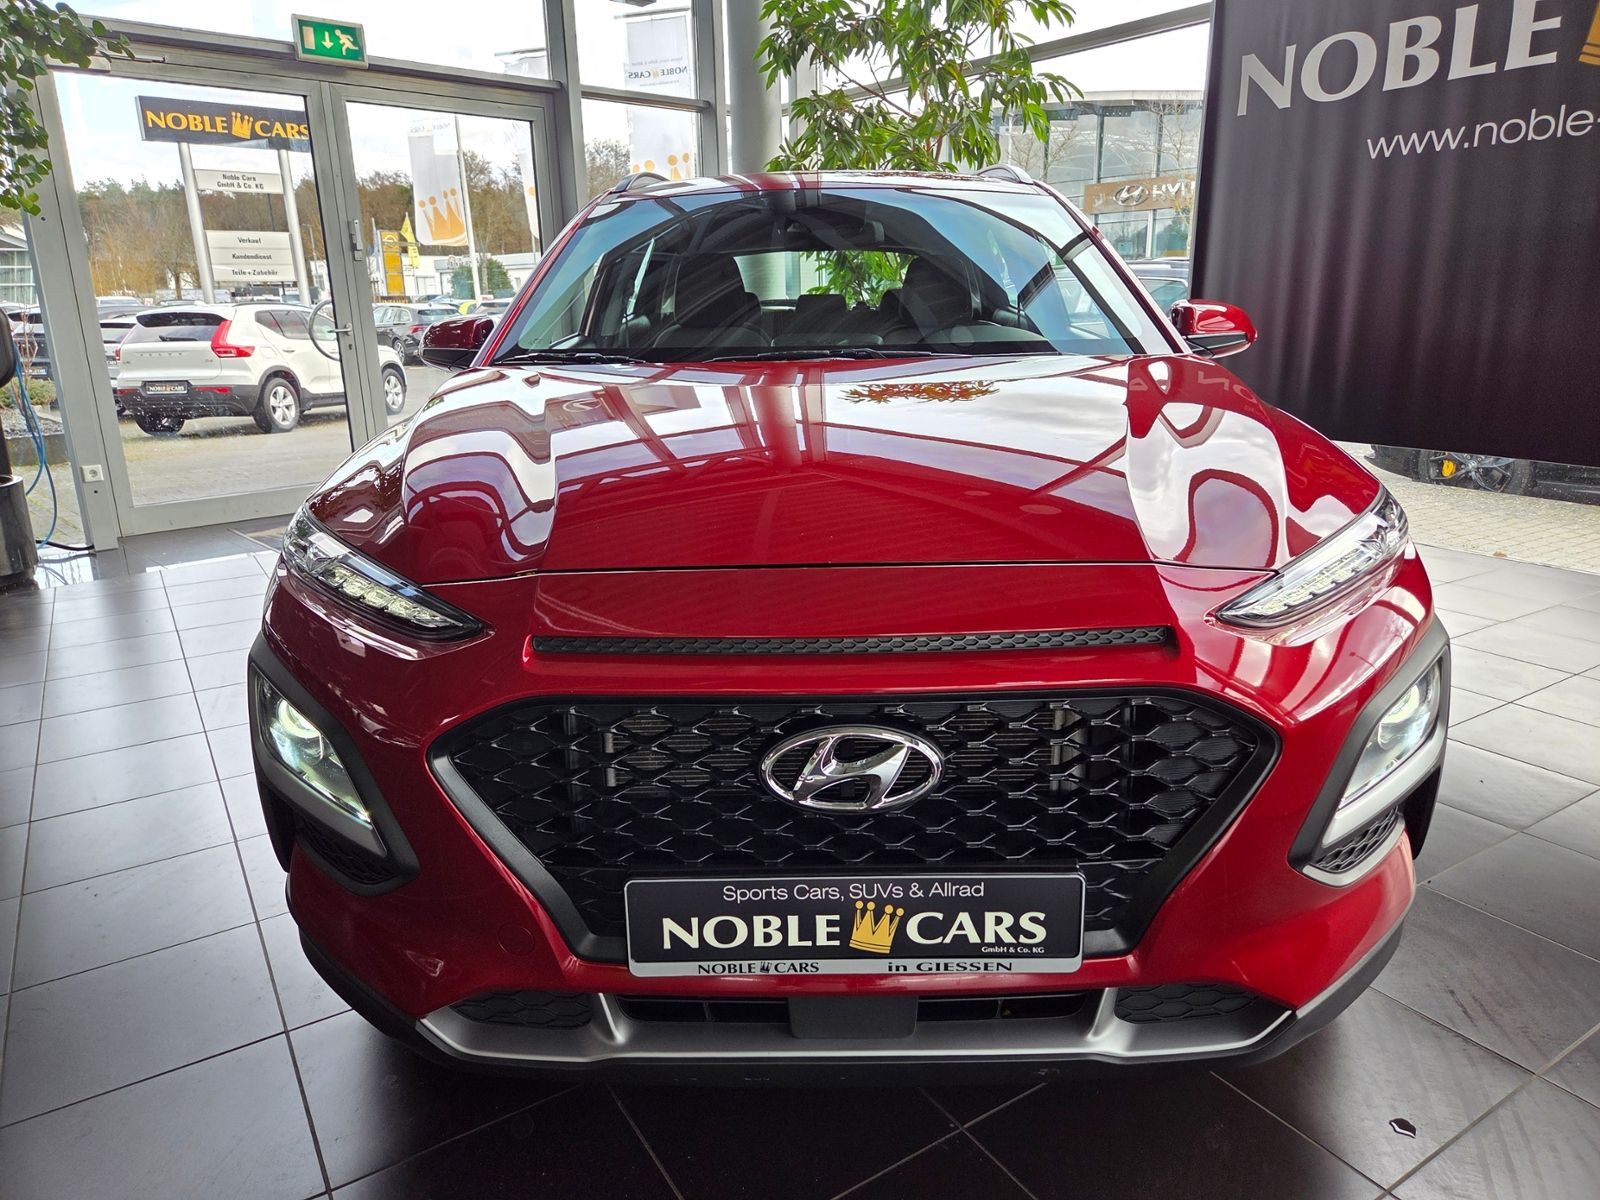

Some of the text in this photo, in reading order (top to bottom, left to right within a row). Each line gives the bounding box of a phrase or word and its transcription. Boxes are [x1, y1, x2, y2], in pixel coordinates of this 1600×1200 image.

[1237, 0, 1563, 117] NOBLE
[145, 111, 308, 139] NOBLE CARS
[222, 173, 256, 182] Noble Cars
[237, 236, 262, 244] Verkauf
[231, 252, 272, 260] Kundendienst
[723, 882, 985, 902] Sports Cars, SUVs & Allrad
[662, 911, 1047, 950] NOBLE CARS
[697, 962, 1013, 974] NOBLE CARS in GIESSEN
